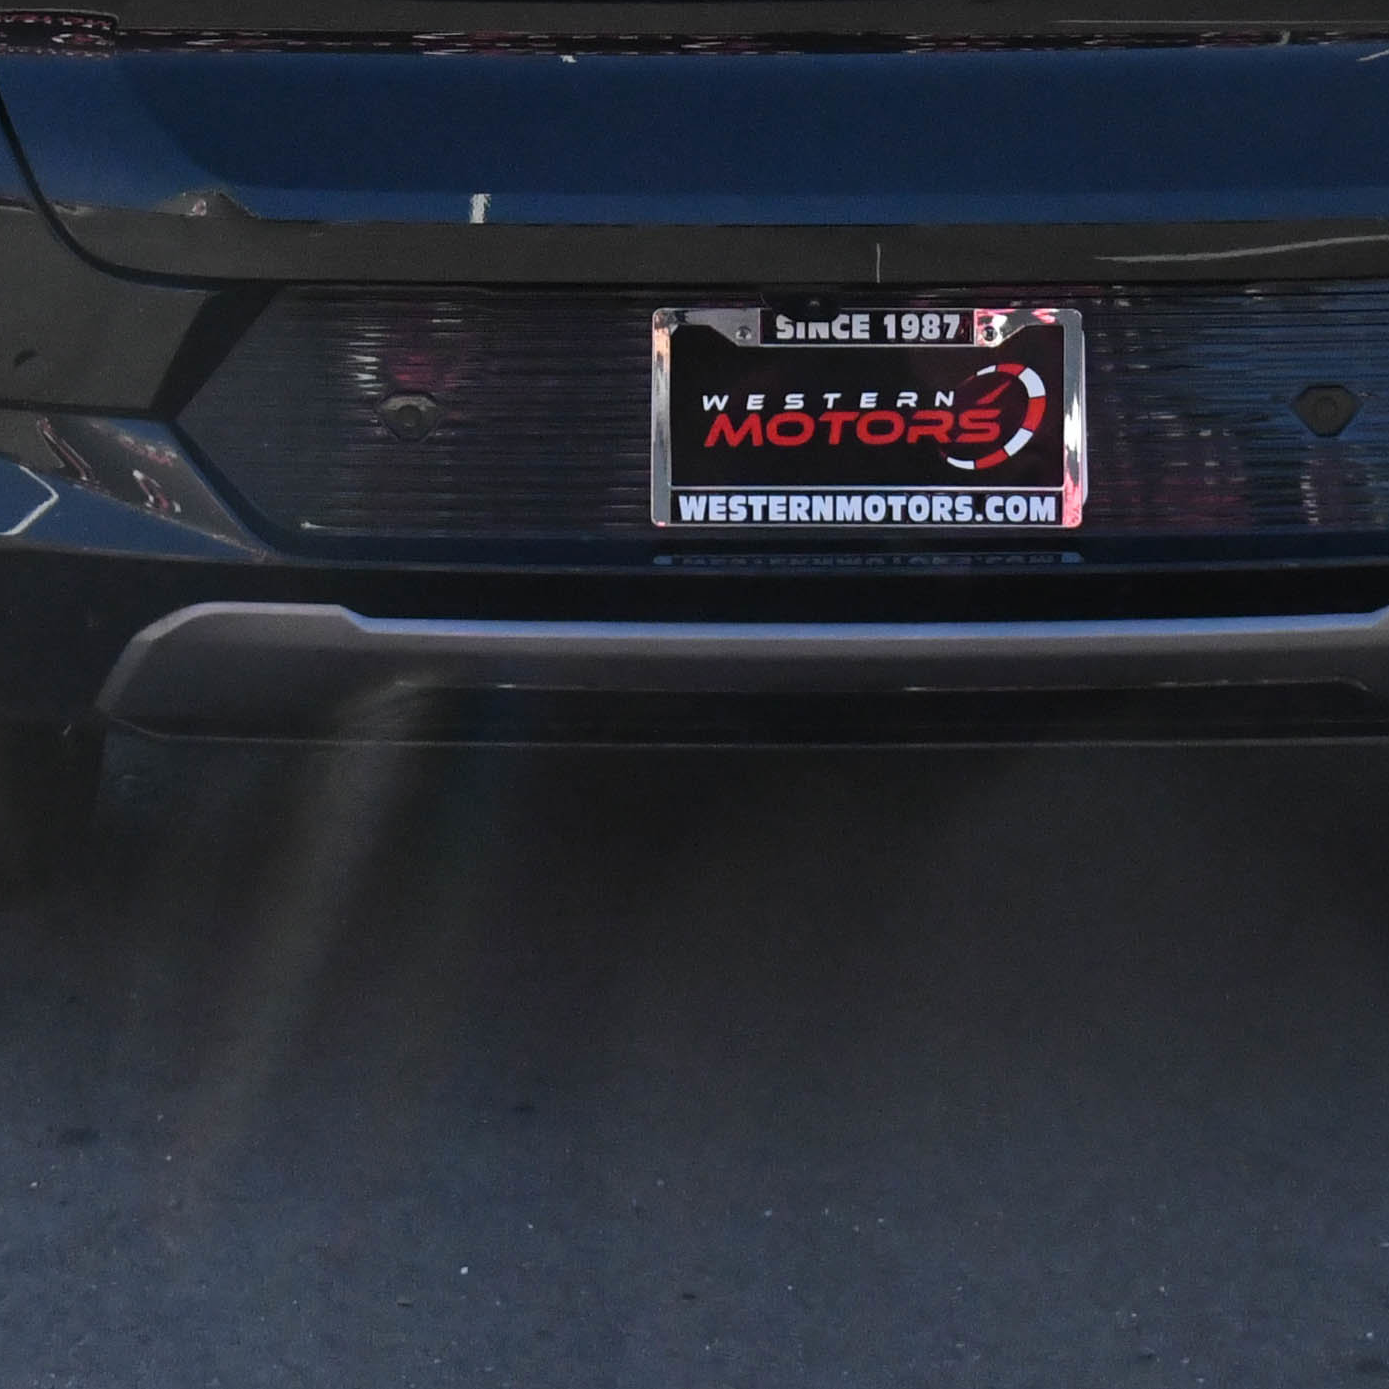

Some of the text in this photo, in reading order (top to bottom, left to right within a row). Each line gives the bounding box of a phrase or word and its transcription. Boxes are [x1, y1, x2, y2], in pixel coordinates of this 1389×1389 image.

[775, 313, 963, 340] SINCE 1987
[702, 390, 956, 412] WESTERN
[704, 408, 1003, 448] MOTORS
[678, 494, 1057, 523] WESTERNMOTORS.COM
